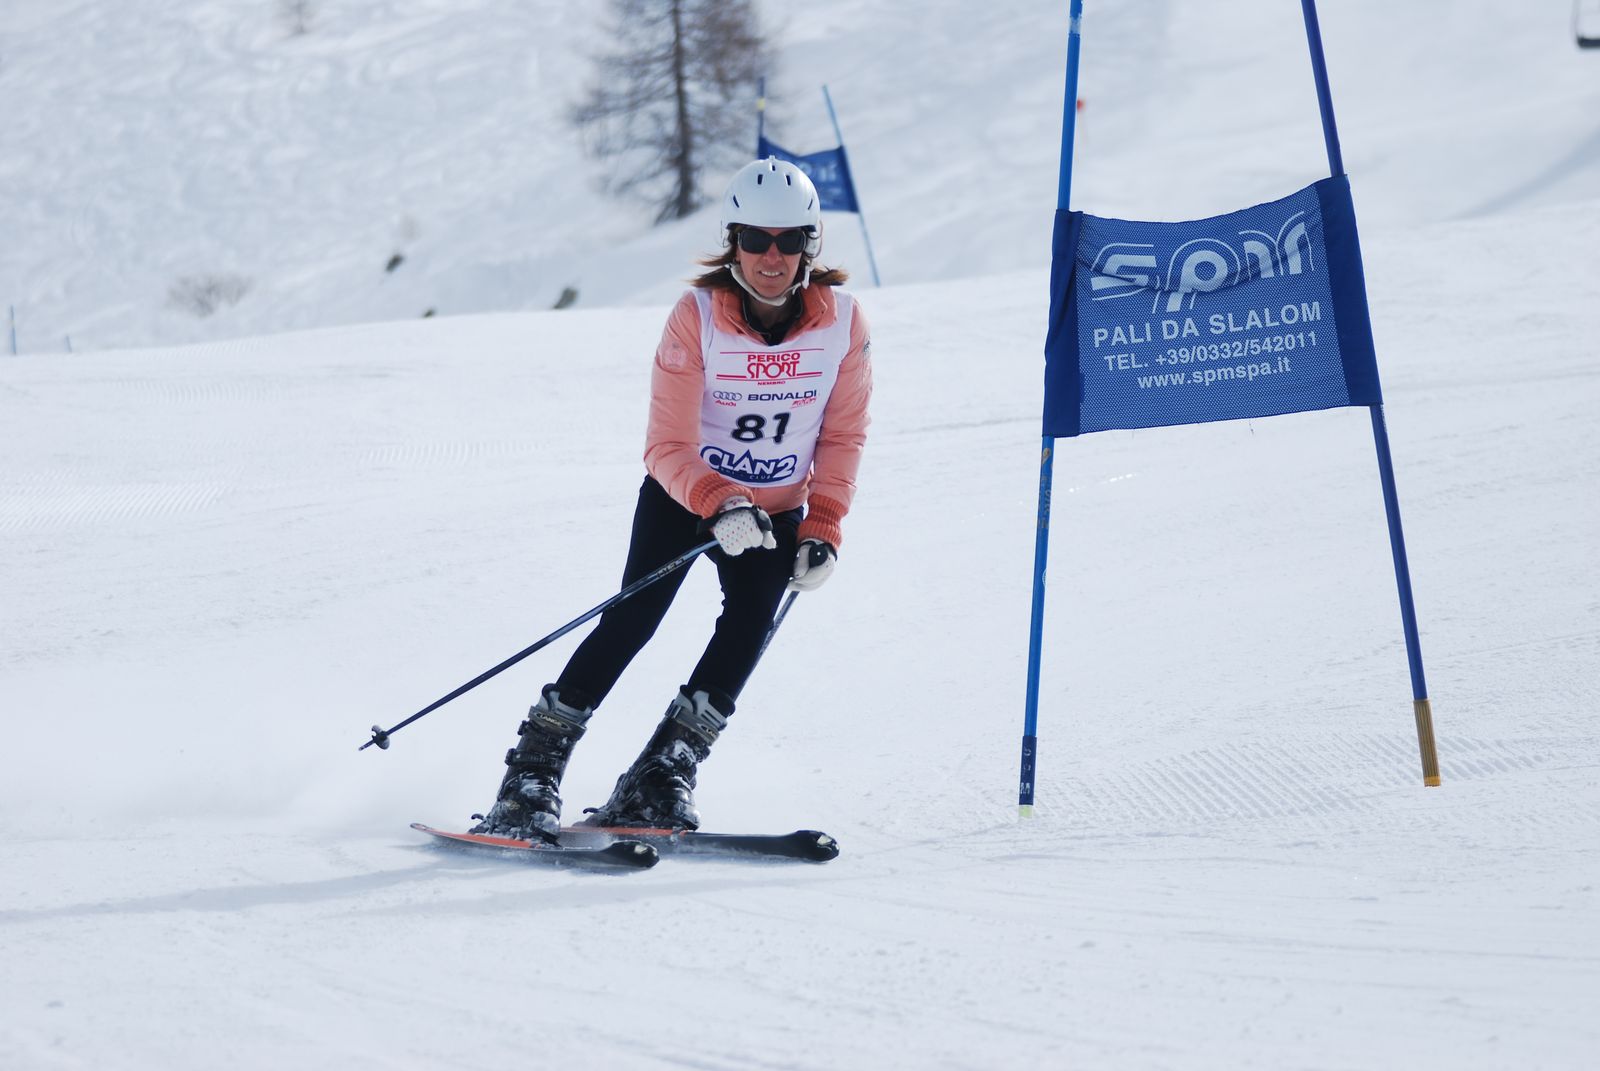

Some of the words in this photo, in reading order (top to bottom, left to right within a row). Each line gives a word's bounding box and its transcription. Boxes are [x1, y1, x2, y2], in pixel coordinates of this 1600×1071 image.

[1093, 322, 1152, 348] PALI
[1162, 317, 1199, 340] DA
[1209, 301, 1321, 335] SLALOM
[747, 352, 801, 362] PERICO
[1104, 353, 1149, 372] TEL.
[1155, 331, 1318, 367] +39/0332/542011
[747, 361, 800, 379] SPORT
[1137, 356, 1291, 389] www.spmspa.it
[748, 389, 817, 401] BONALDI
[731, 411, 791, 444] 81
[700, 446, 797, 479] CLAN2
